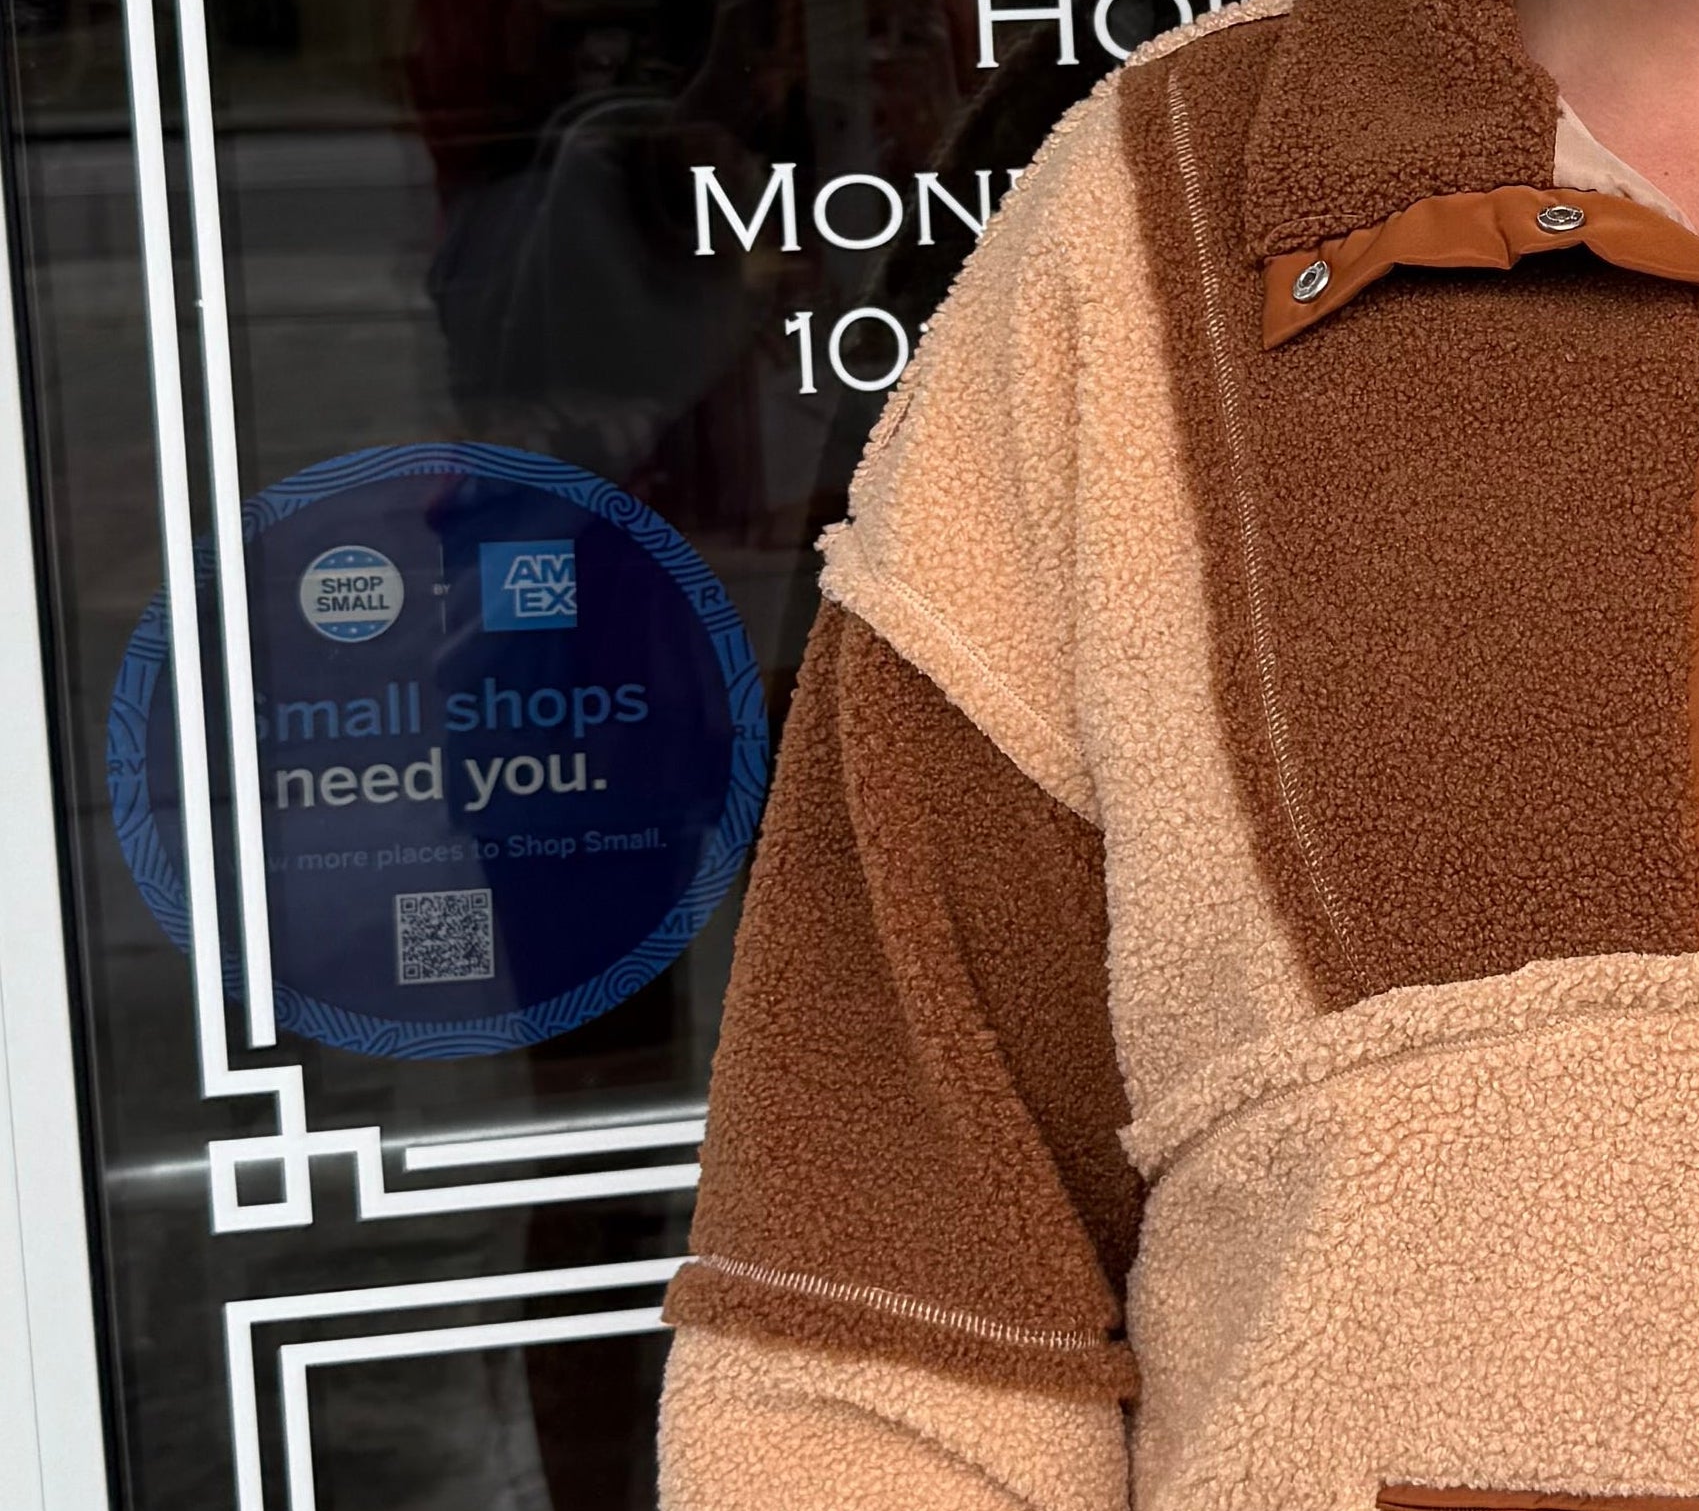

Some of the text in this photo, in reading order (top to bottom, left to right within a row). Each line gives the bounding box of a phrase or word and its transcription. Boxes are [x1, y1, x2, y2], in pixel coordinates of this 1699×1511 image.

[690, 162, 1024, 255] MON
[320, 576, 384, 595] SHOP
[504, 553, 575, 590] AM
[316, 594, 391, 612] SMALL
[515, 587, 577, 618] EX
[445, 677, 650, 738] shops
[276, 746, 607, 811] need you.
[299, 851, 369, 870] more
[376, 840, 464, 870] places
[471, 838, 499, 859] to
[506, 833, 577, 858] Shop
[584, 827, 668, 852] Small.
